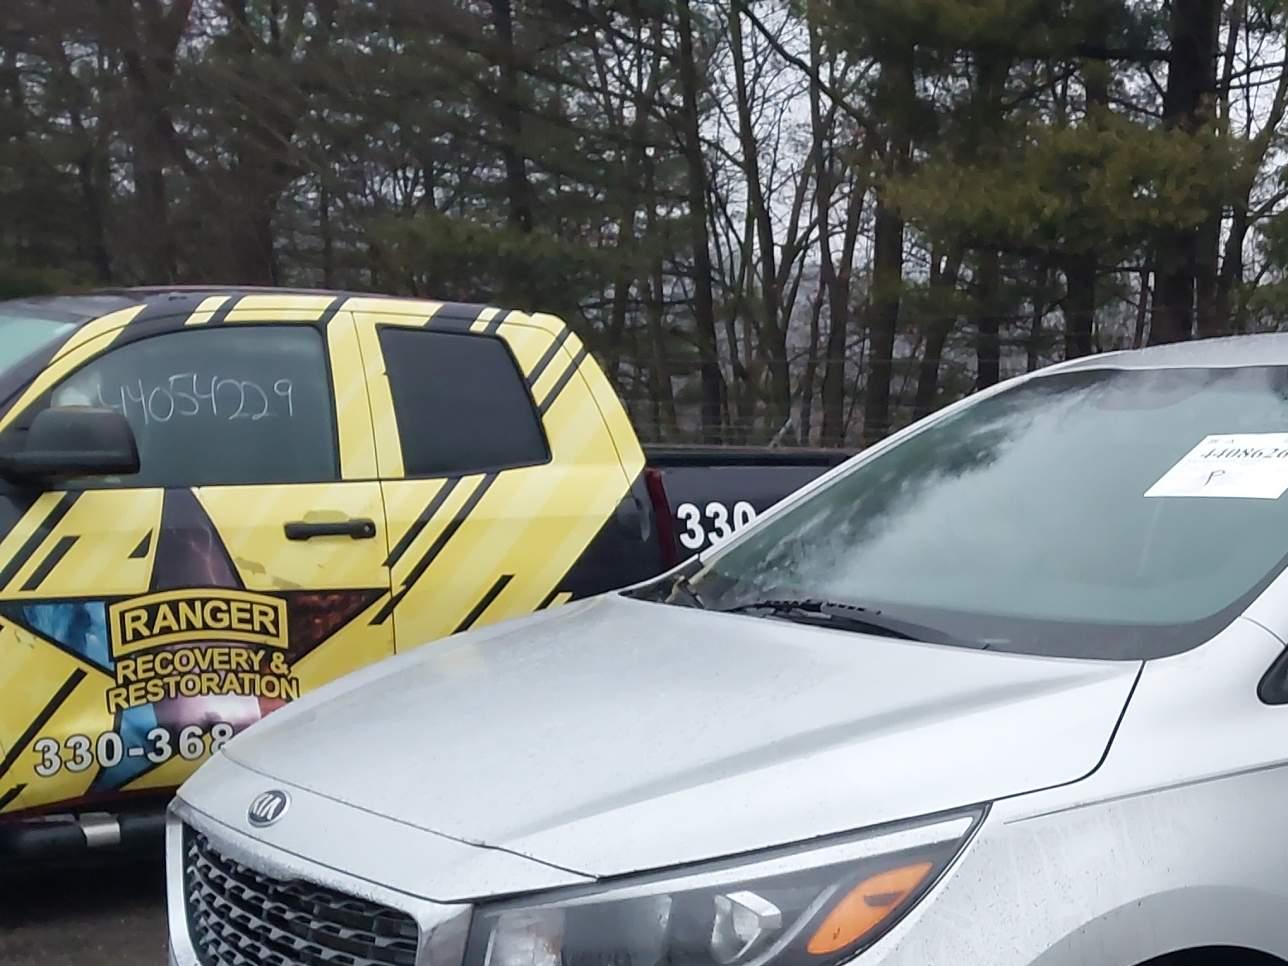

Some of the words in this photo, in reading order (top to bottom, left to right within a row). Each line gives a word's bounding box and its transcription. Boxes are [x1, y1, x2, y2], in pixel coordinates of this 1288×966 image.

[96, 373, 293, 425] 44054229
[123, 600, 278, 642] RANGER
[116, 648, 265, 685] RECOVERY
[269, 651, 290, 676] &
[107, 673, 300, 714] RESTORATION
